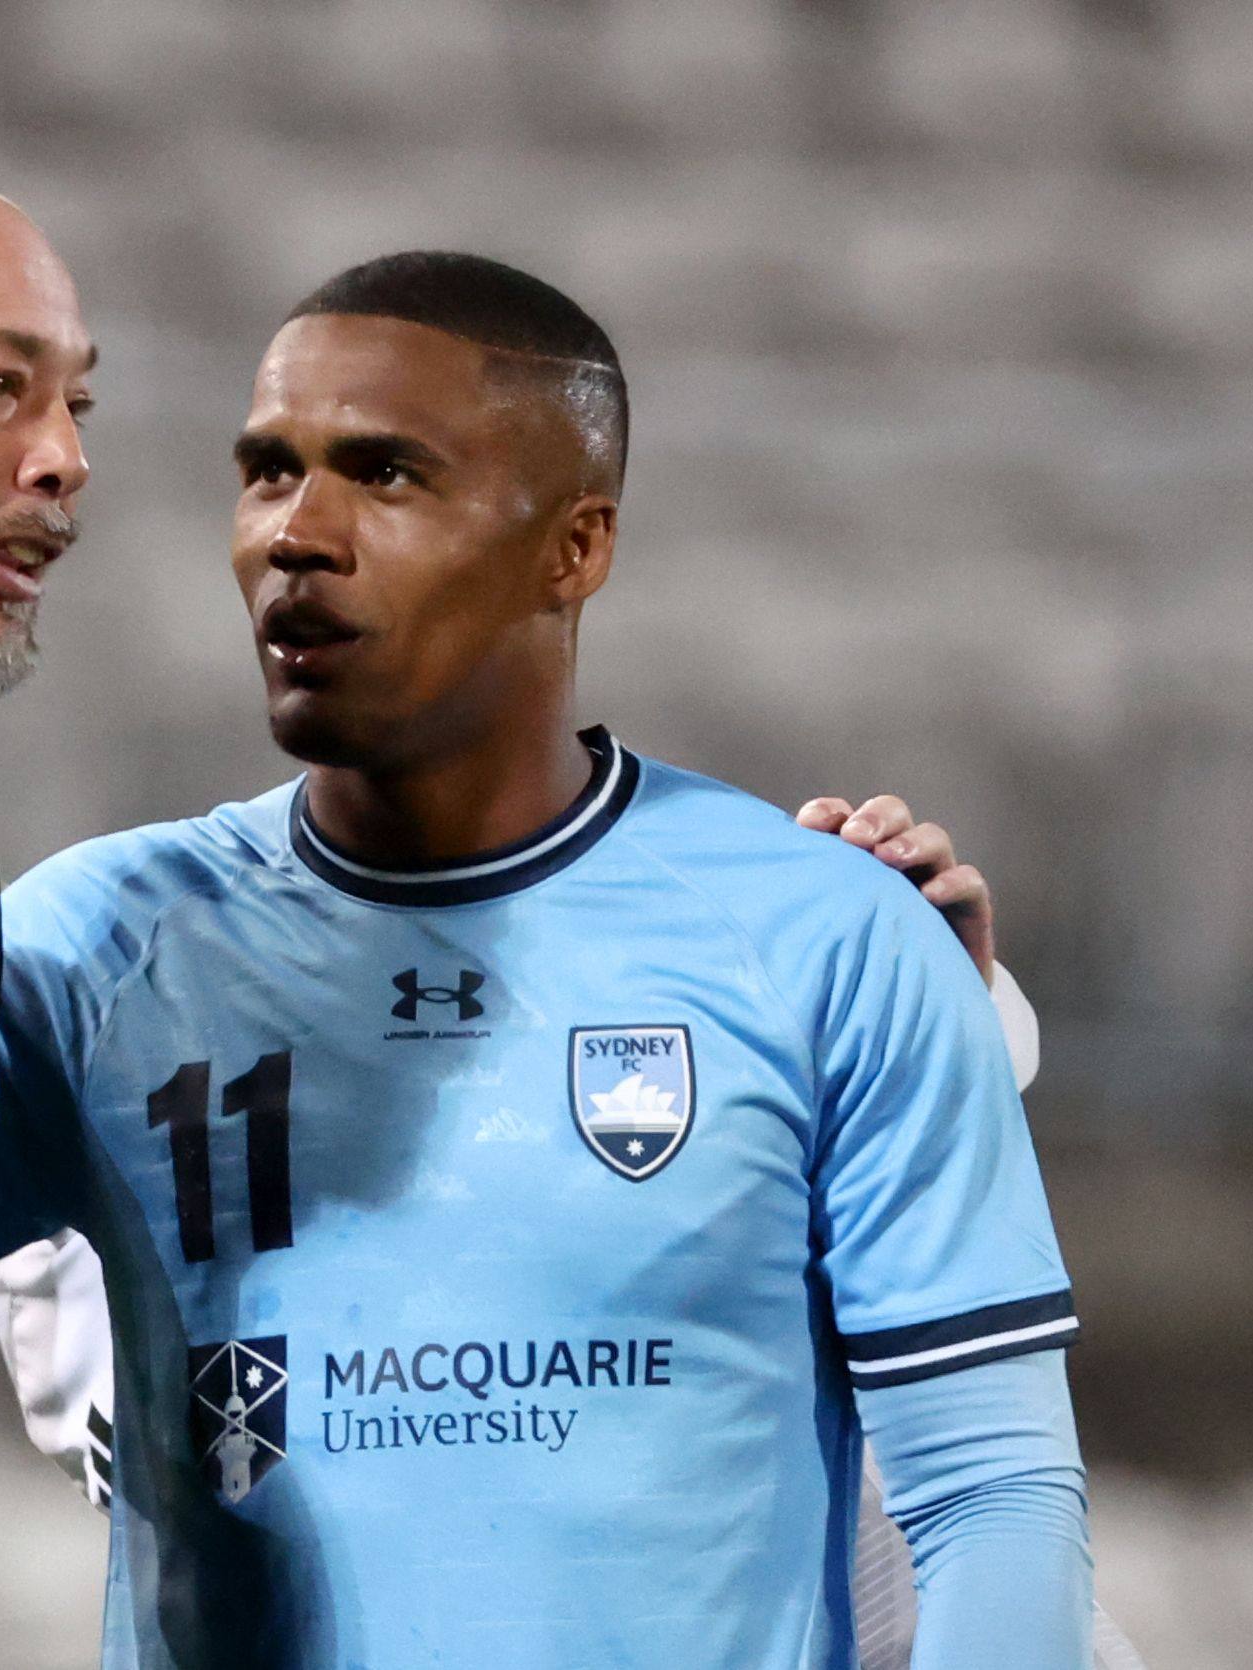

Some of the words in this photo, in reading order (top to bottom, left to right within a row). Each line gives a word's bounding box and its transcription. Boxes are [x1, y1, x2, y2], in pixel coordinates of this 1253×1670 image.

[584, 1036, 674, 1058] SYDNEY
[621, 1058, 641, 1072] FC
[147, 1050, 294, 1264] 11
[324, 1339, 673, 1400] MACQUARIE
[322, 1400, 578, 1453] University
